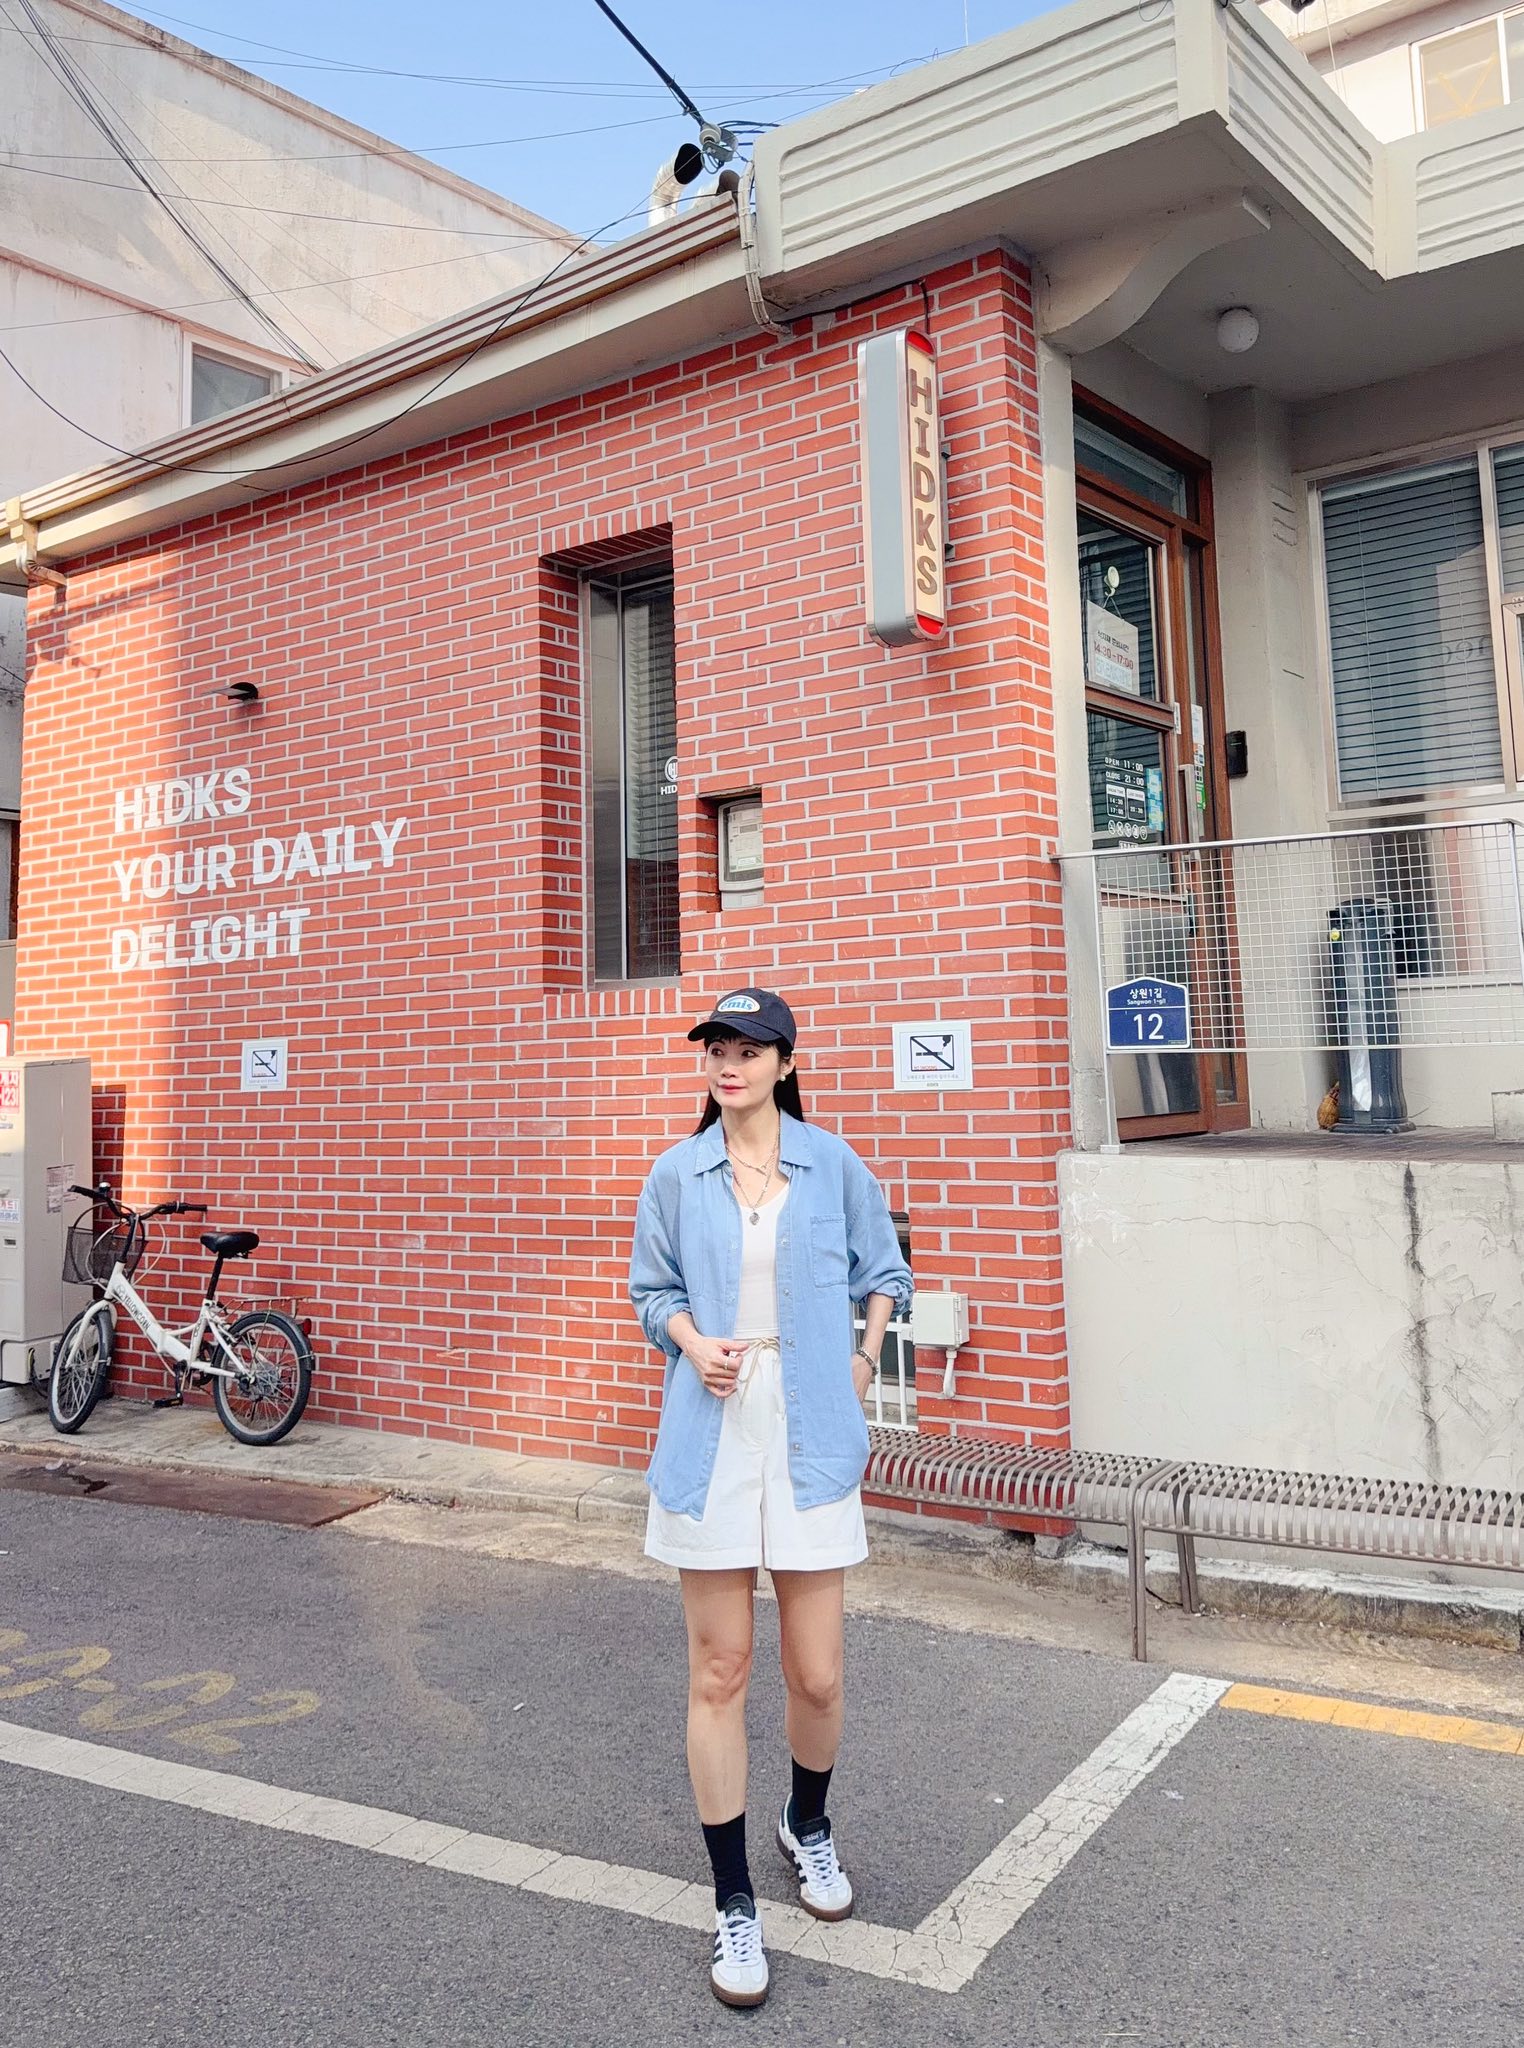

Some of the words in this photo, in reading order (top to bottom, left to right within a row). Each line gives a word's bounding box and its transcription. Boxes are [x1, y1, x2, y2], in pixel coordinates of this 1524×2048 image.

[909, 368, 938, 596] HIDKS
[1105, 757, 1120, 767] OPEN
[1123, 759, 1144, 772] 11:00
[1105, 771, 1121, 781] CLOSE
[1124, 774, 1145, 786] 21:00
[114, 767, 251, 833] HIDKS
[113, 843, 236, 902] YOUR
[253, 817, 407, 885] DAILY
[112, 908, 311, 973] DELIGHT
[720, 1000, 753, 1011] emis
[1130, 988, 1163, 999] 상원1길
[1133, 1013, 1165, 1040] 12
